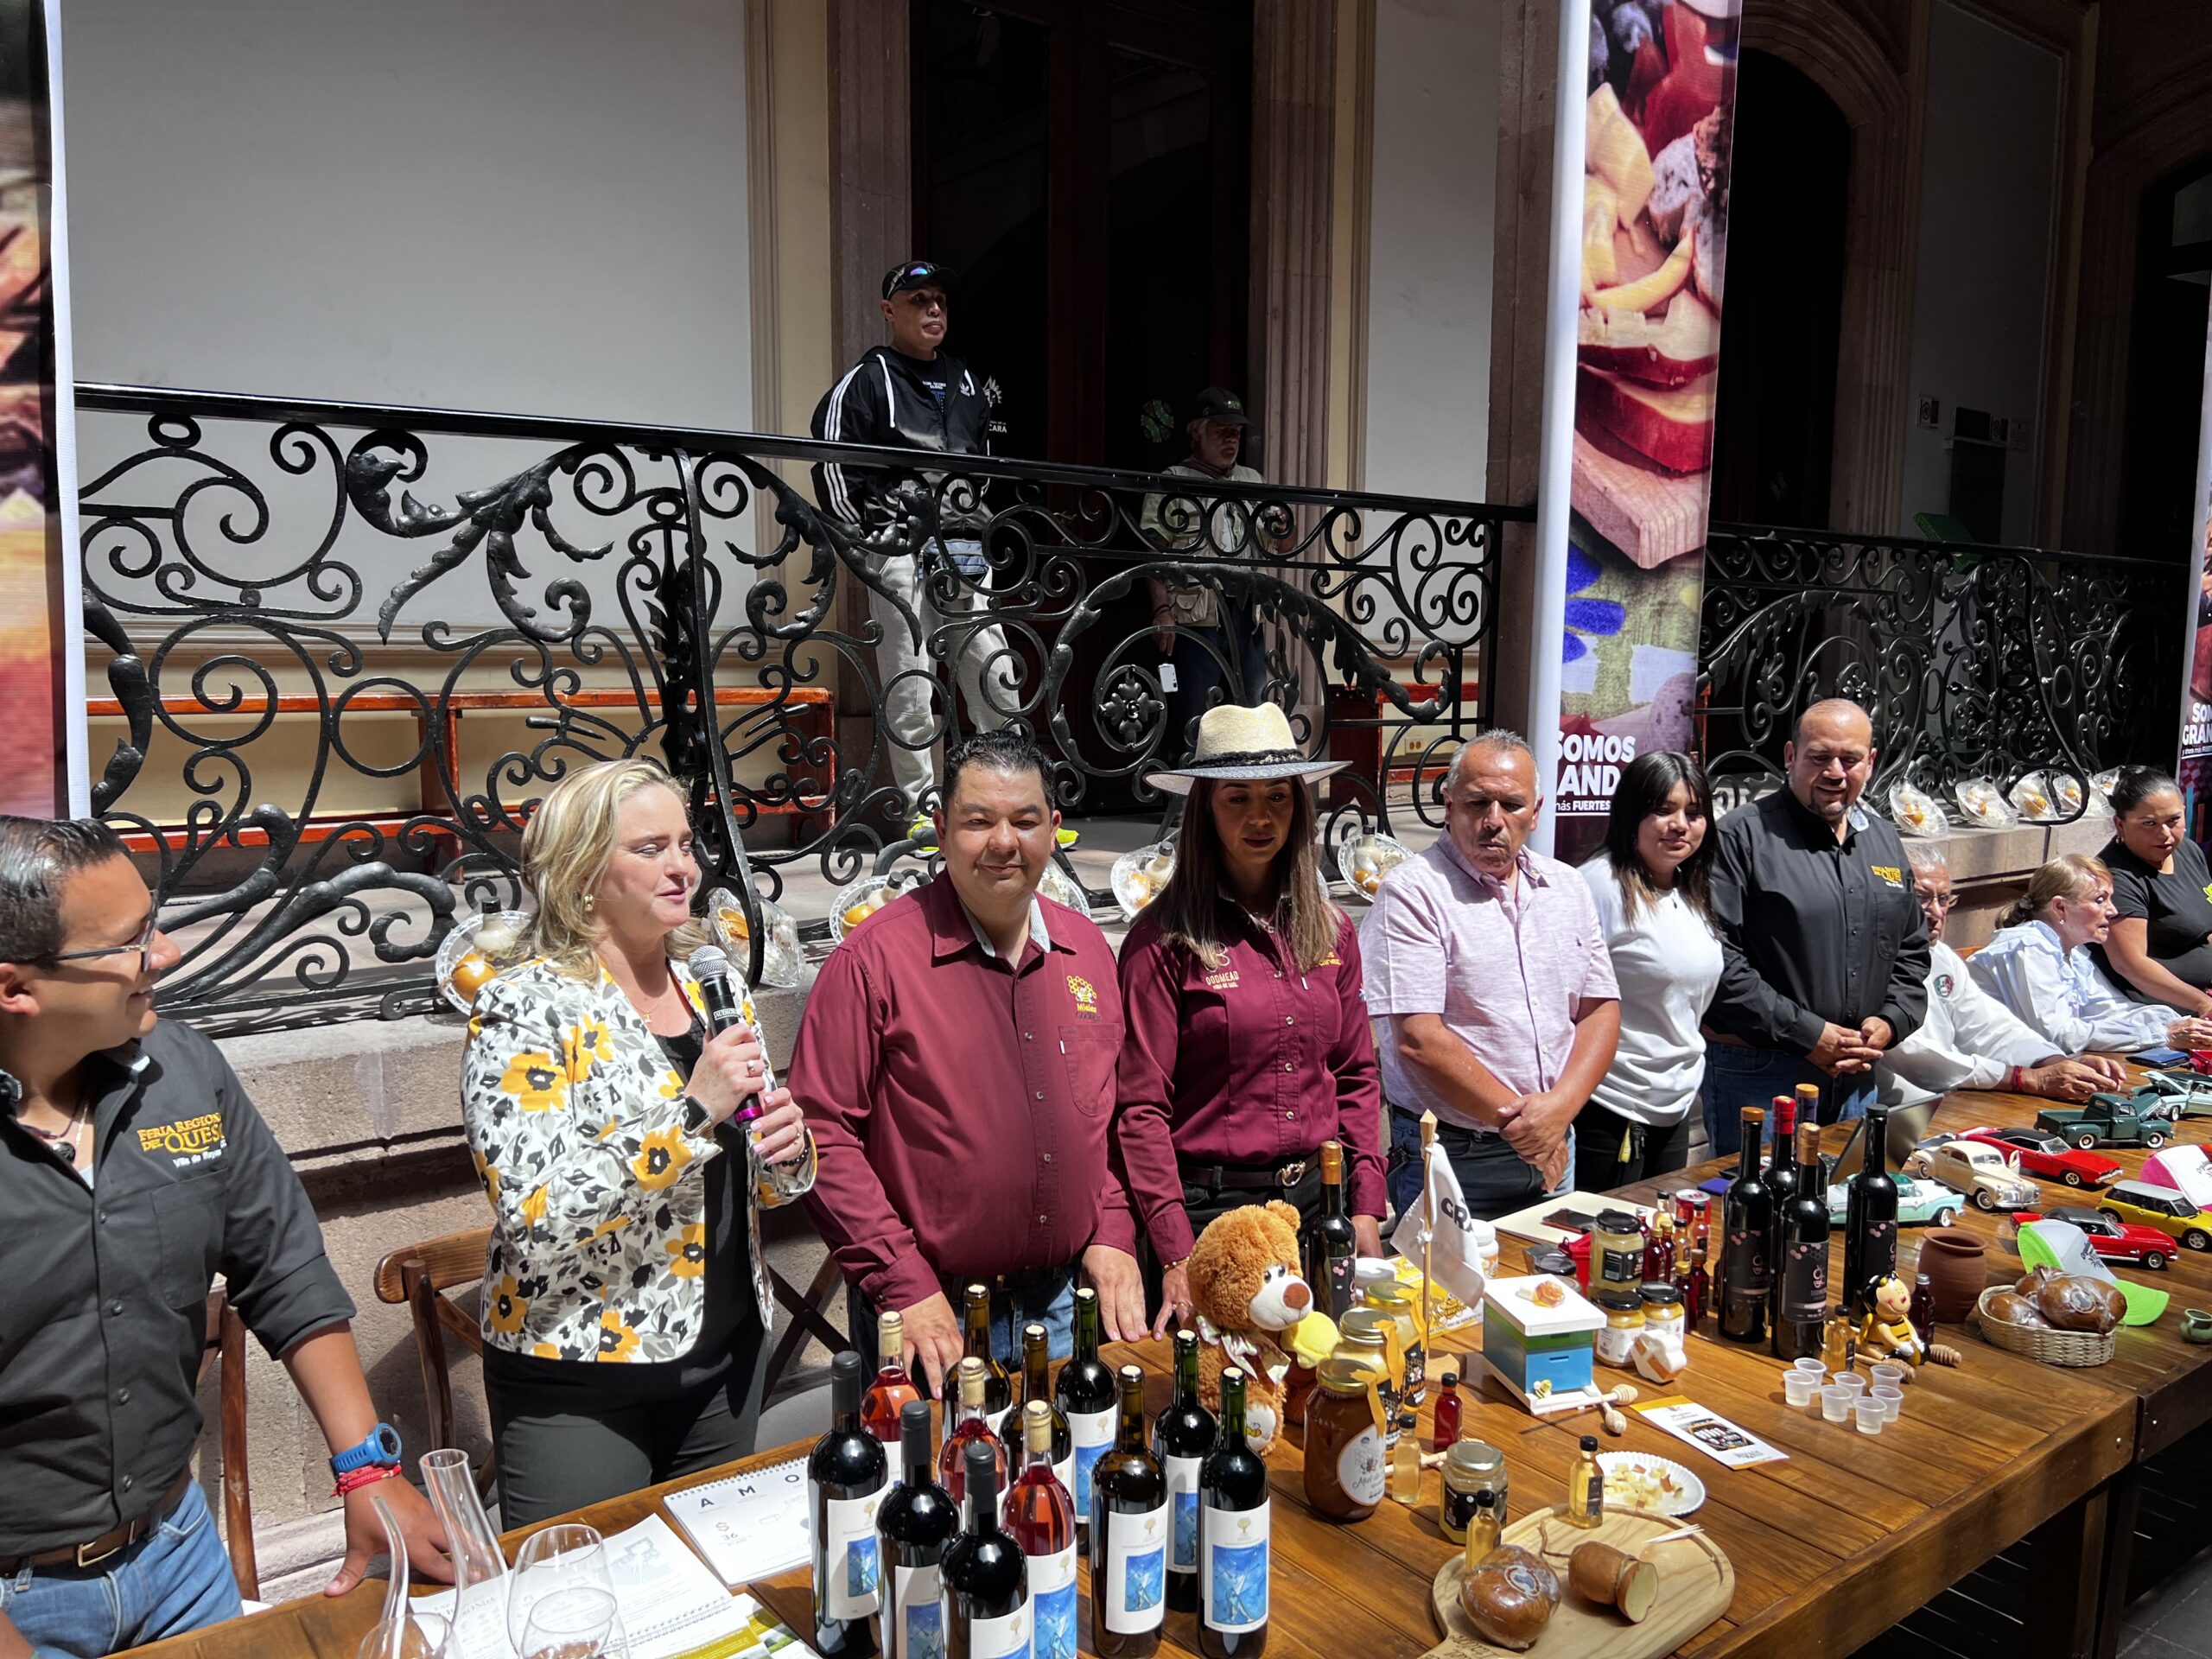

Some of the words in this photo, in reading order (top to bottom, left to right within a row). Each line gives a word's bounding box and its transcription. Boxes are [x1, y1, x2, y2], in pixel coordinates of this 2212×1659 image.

[1555, 730, 1637, 764] SOMOS
[1573, 800, 1611, 811] FUERTES
[137, 1125, 176, 1141] FERIA
[141, 1139, 164, 1152] DEL
